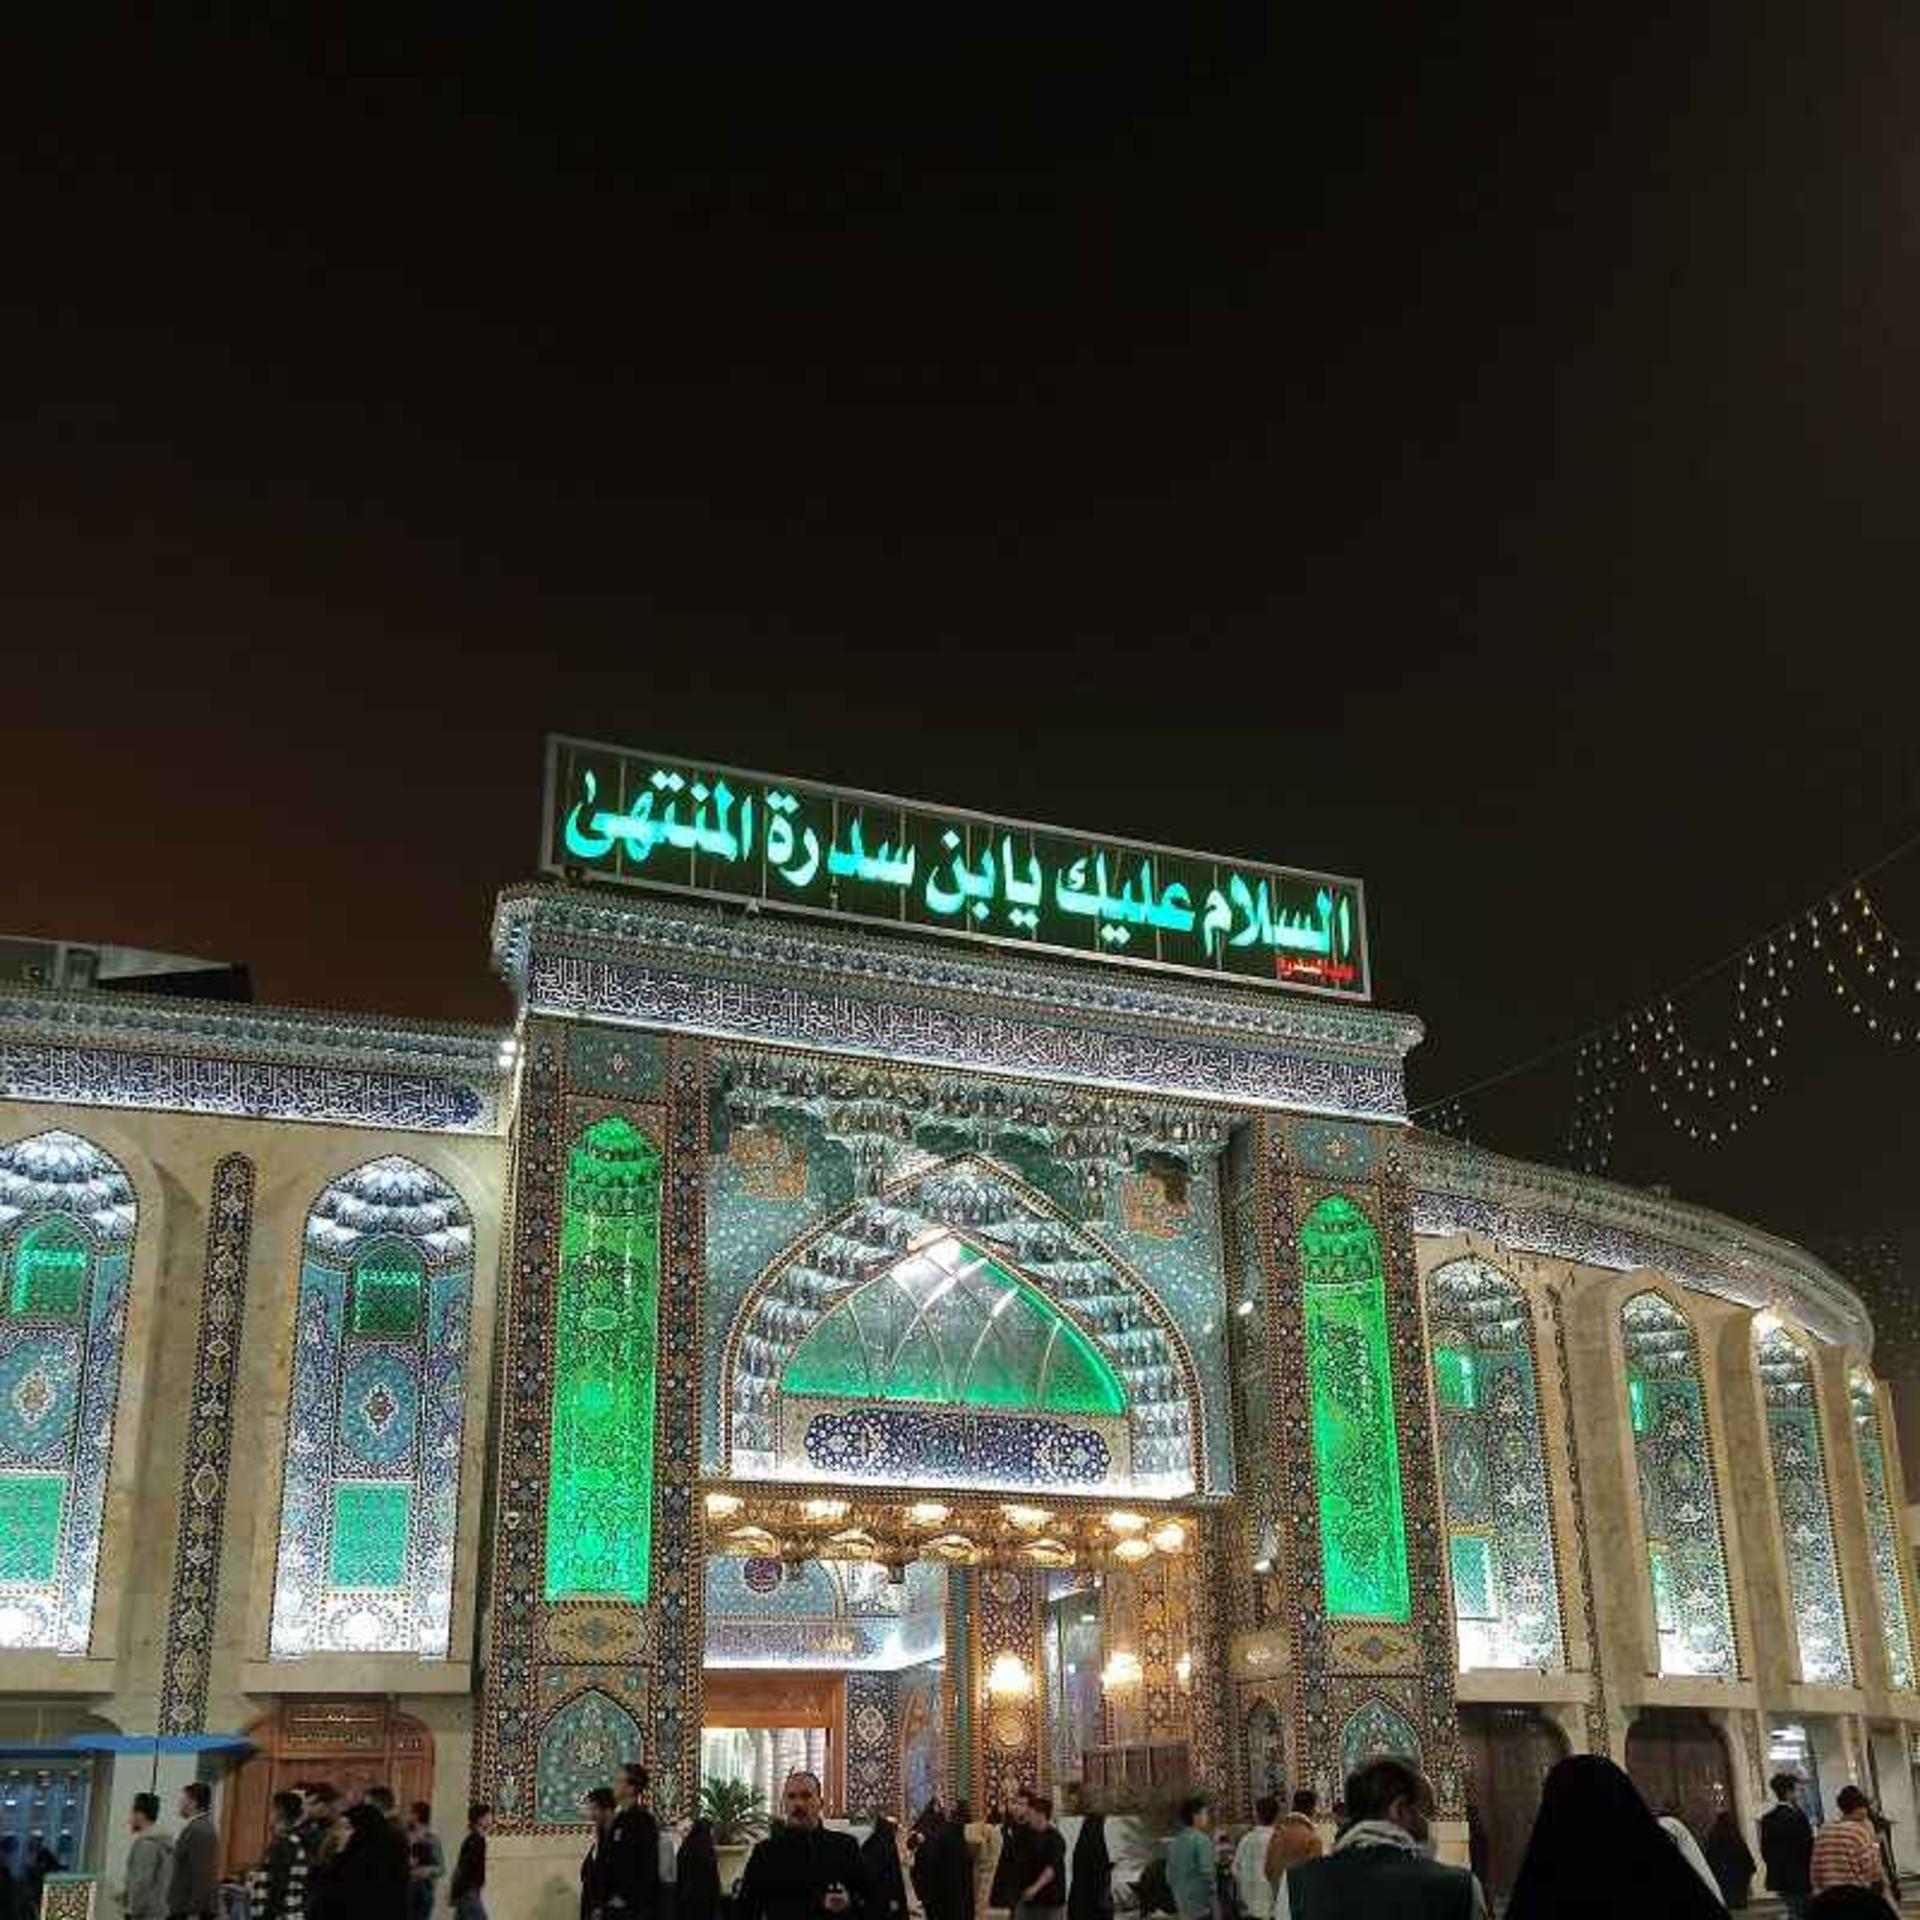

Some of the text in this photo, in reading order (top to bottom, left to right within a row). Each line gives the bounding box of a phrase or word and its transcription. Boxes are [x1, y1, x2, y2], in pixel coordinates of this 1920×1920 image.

[765, 791, 915, 887] سدرة
[1055, 850, 1196, 944] عليك
[1203, 872, 1350, 957] السلام
